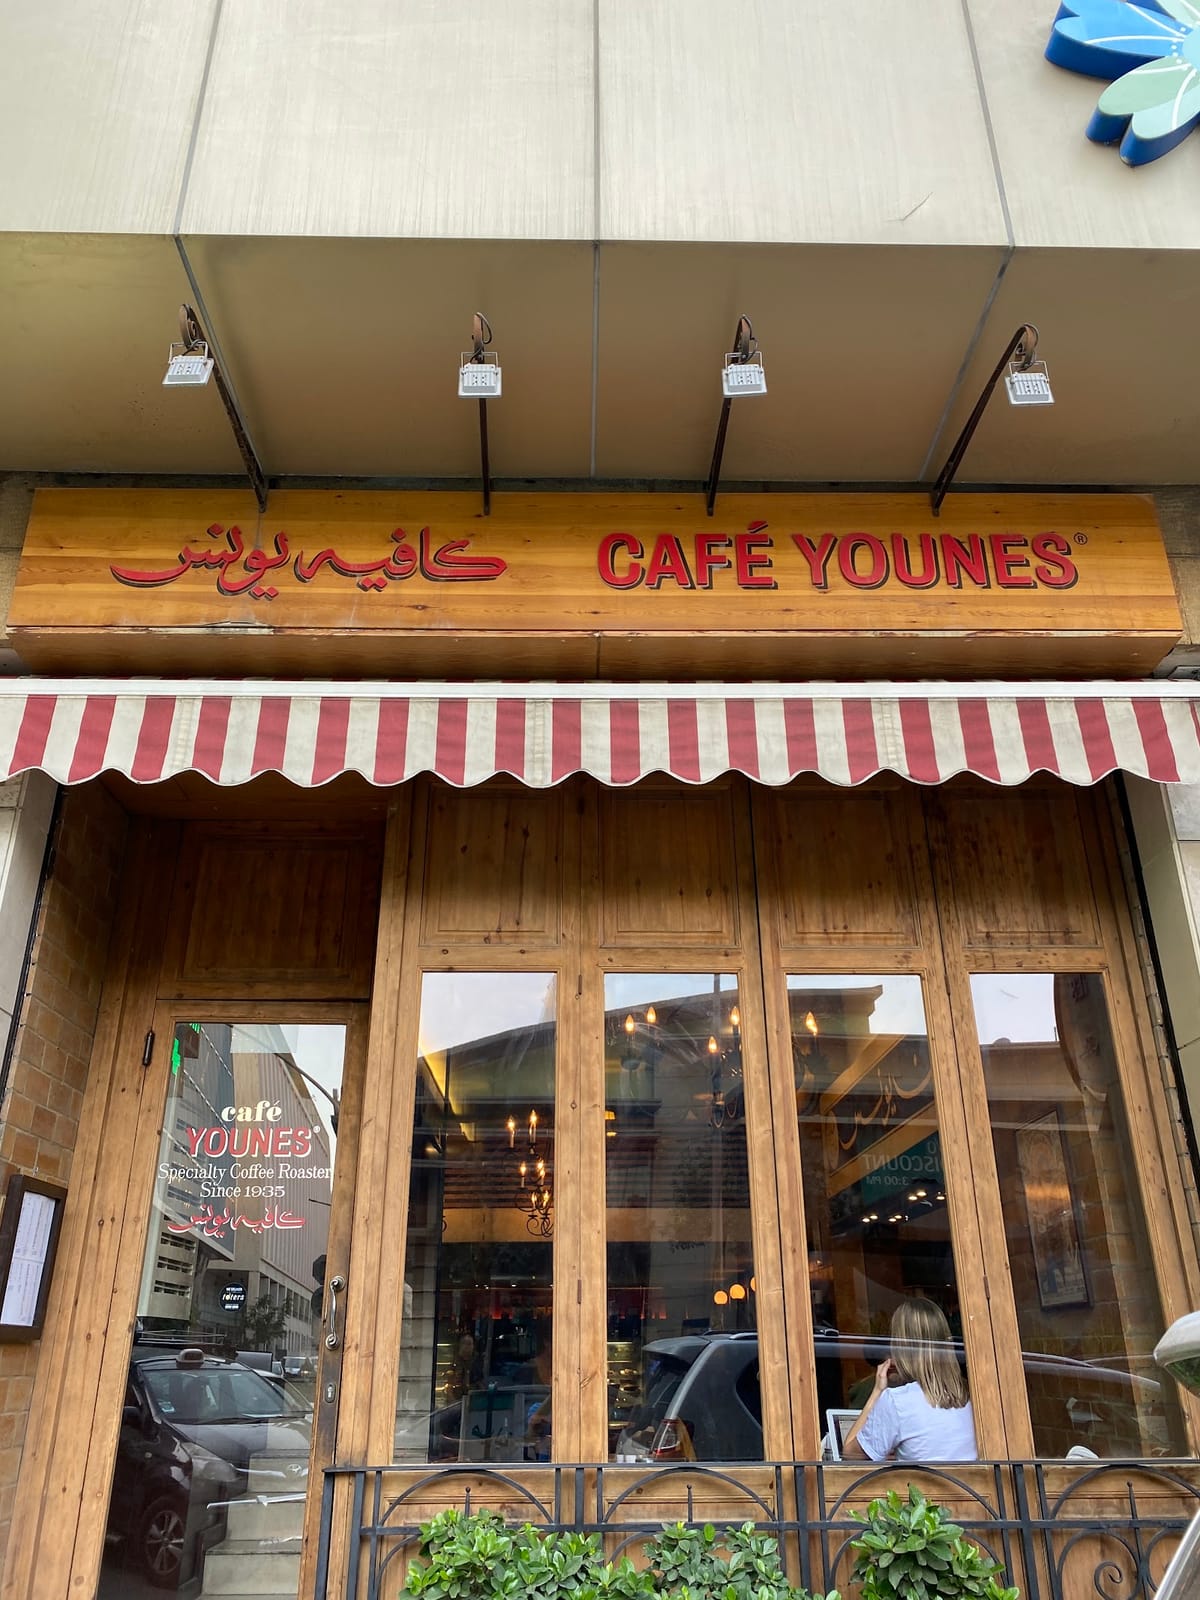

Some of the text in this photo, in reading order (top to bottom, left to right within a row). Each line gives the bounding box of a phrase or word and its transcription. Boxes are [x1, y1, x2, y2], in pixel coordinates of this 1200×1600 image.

[109, 522, 508, 602] كافيه يونس
[597, 520, 778, 591] CAFÉ
[221, 1099, 282, 1122] café
[157, 1162, 228, 1186] Specialty
[229, 1162, 275, 1180] Coffee
[199, 1182, 286, 1198] Since 1935
[167, 1203, 307, 1239] كافيه يونس
